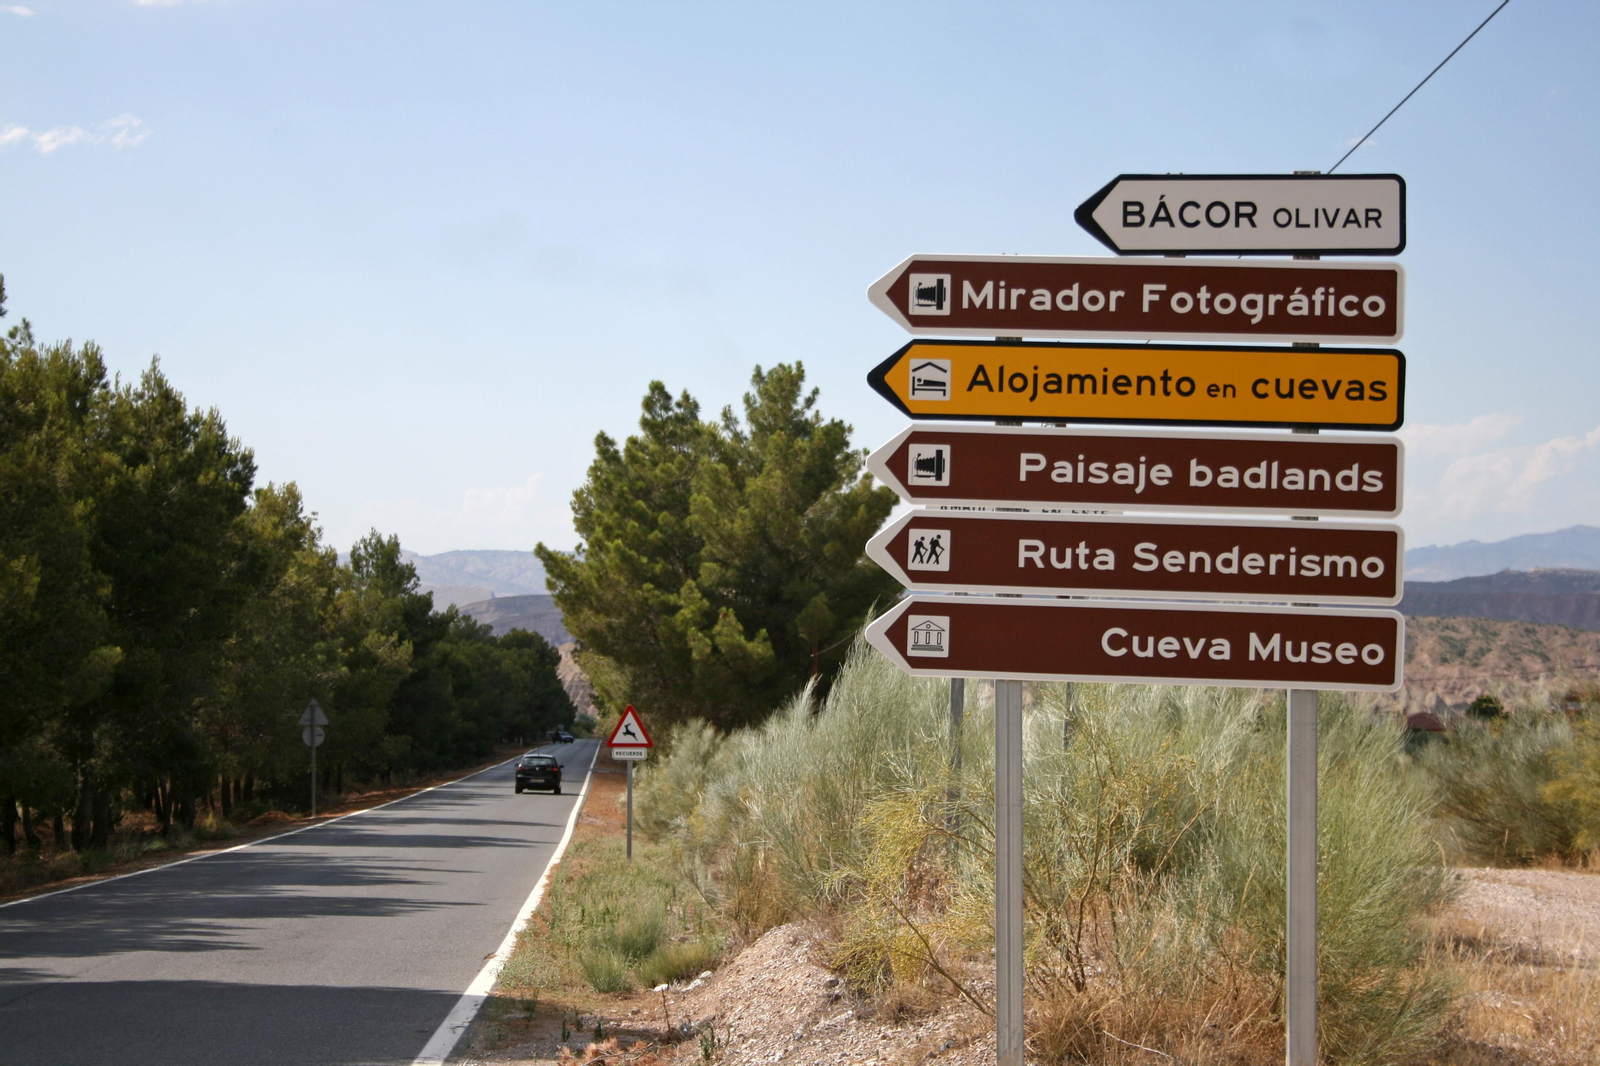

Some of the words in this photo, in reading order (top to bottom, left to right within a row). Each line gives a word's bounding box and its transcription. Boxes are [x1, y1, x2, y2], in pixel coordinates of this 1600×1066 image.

[1123, 195, 1257, 228] BÁCOR
[1273, 208, 1382, 228] OLIVAR
[963, 281, 1125, 311] Mirador
[1143, 284, 1385, 324] Fotográfico
[967, 365, 1195, 402] Alojamiento
[1207, 384, 1236, 398] en
[1252, 378, 1387, 401] cuevas
[1020, 453, 1172, 494] Paisaje
[1190, 458, 1383, 492] badlands
[1019, 539, 1114, 570] Ruta
[1133, 542, 1384, 578] Senderismo
[1102, 628, 1230, 660] Cueva
[1249, 633, 1384, 665] Museo
